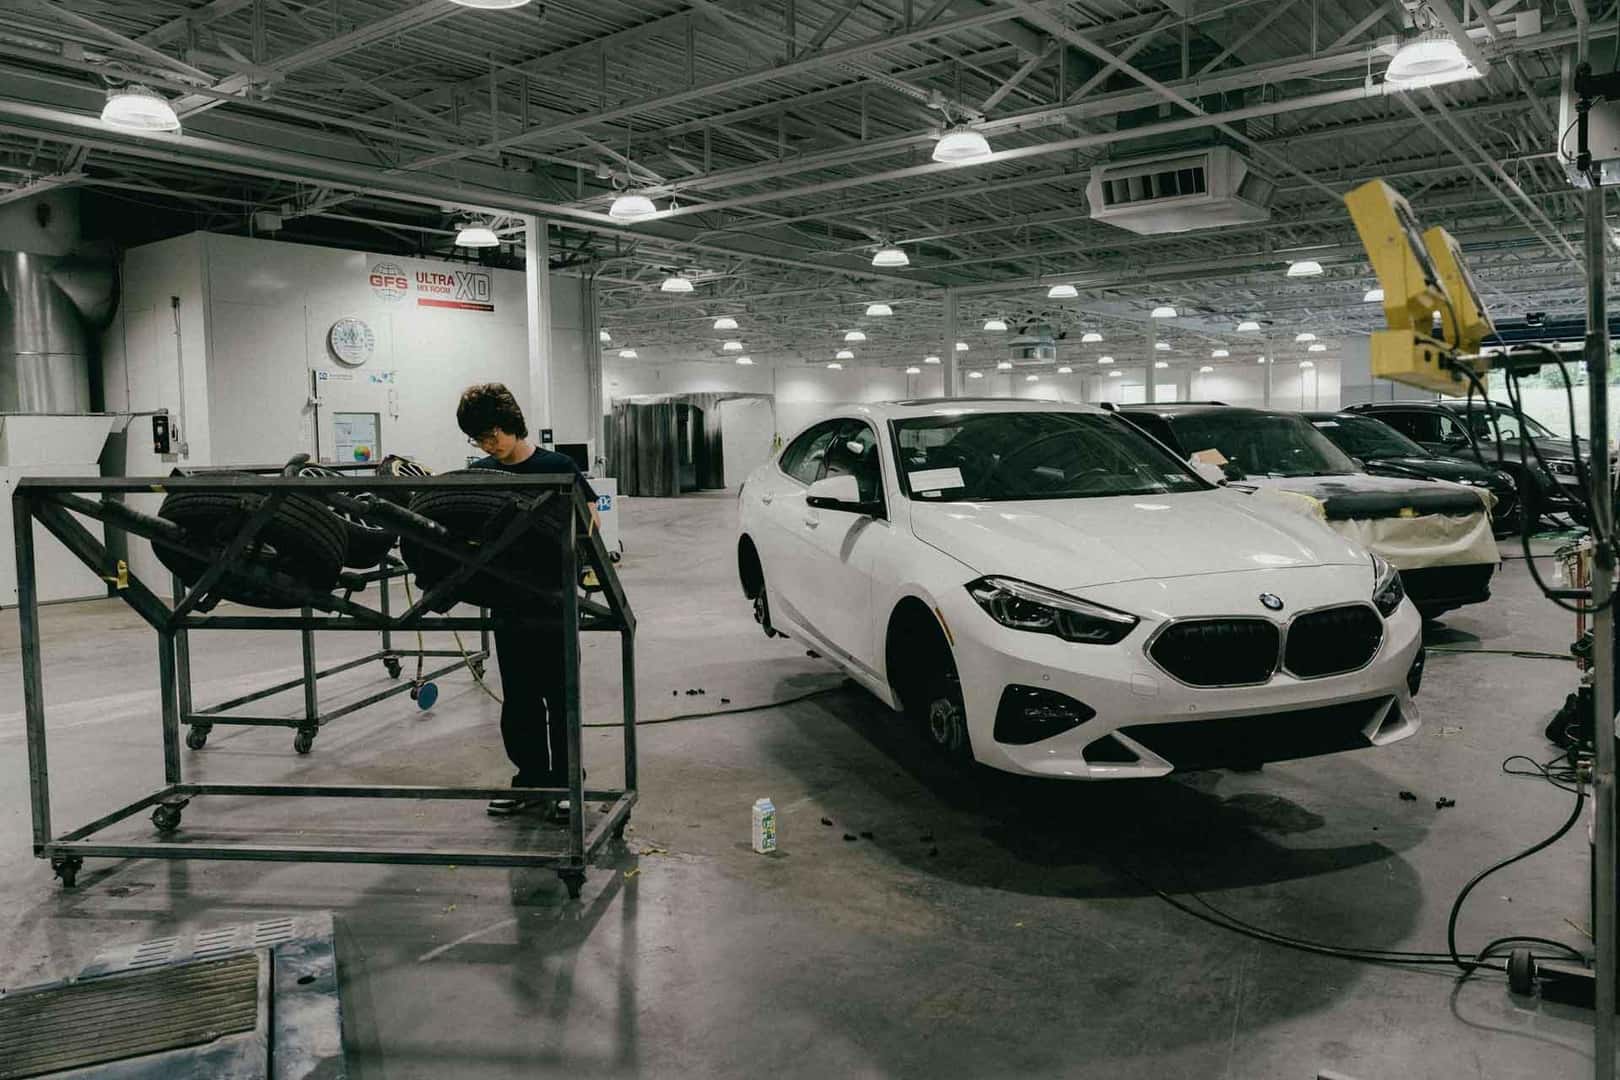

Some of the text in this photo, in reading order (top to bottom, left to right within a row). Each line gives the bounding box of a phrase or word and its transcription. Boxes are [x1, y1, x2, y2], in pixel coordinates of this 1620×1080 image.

[369, 275, 408, 289] GFS
[416, 270, 491, 302] ULTRA XD
